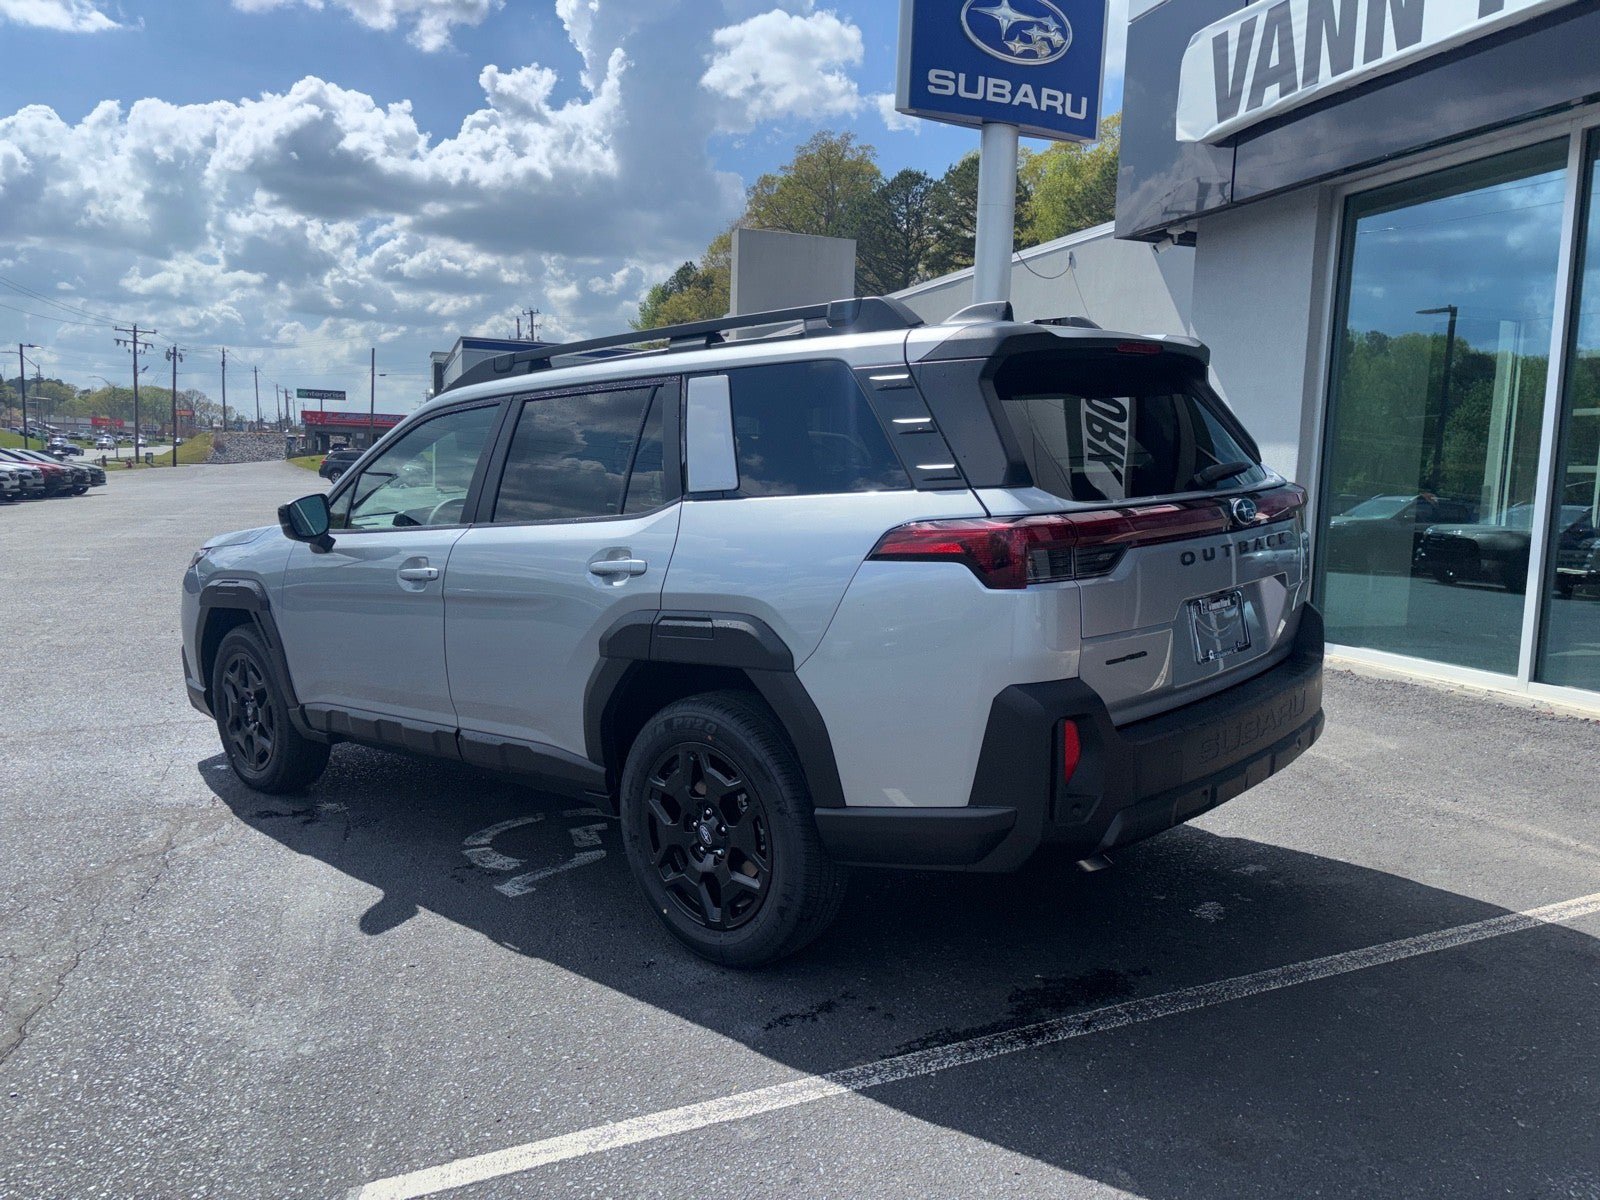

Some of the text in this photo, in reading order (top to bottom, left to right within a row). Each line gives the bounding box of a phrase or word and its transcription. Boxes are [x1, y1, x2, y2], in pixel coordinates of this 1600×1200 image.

[927, 68, 1088, 120] SUBARU
[297, 389, 345, 399] enterprise
[1180, 531, 1287, 566] OUTBACK
[1200, 688, 1306, 763] SUBARU
